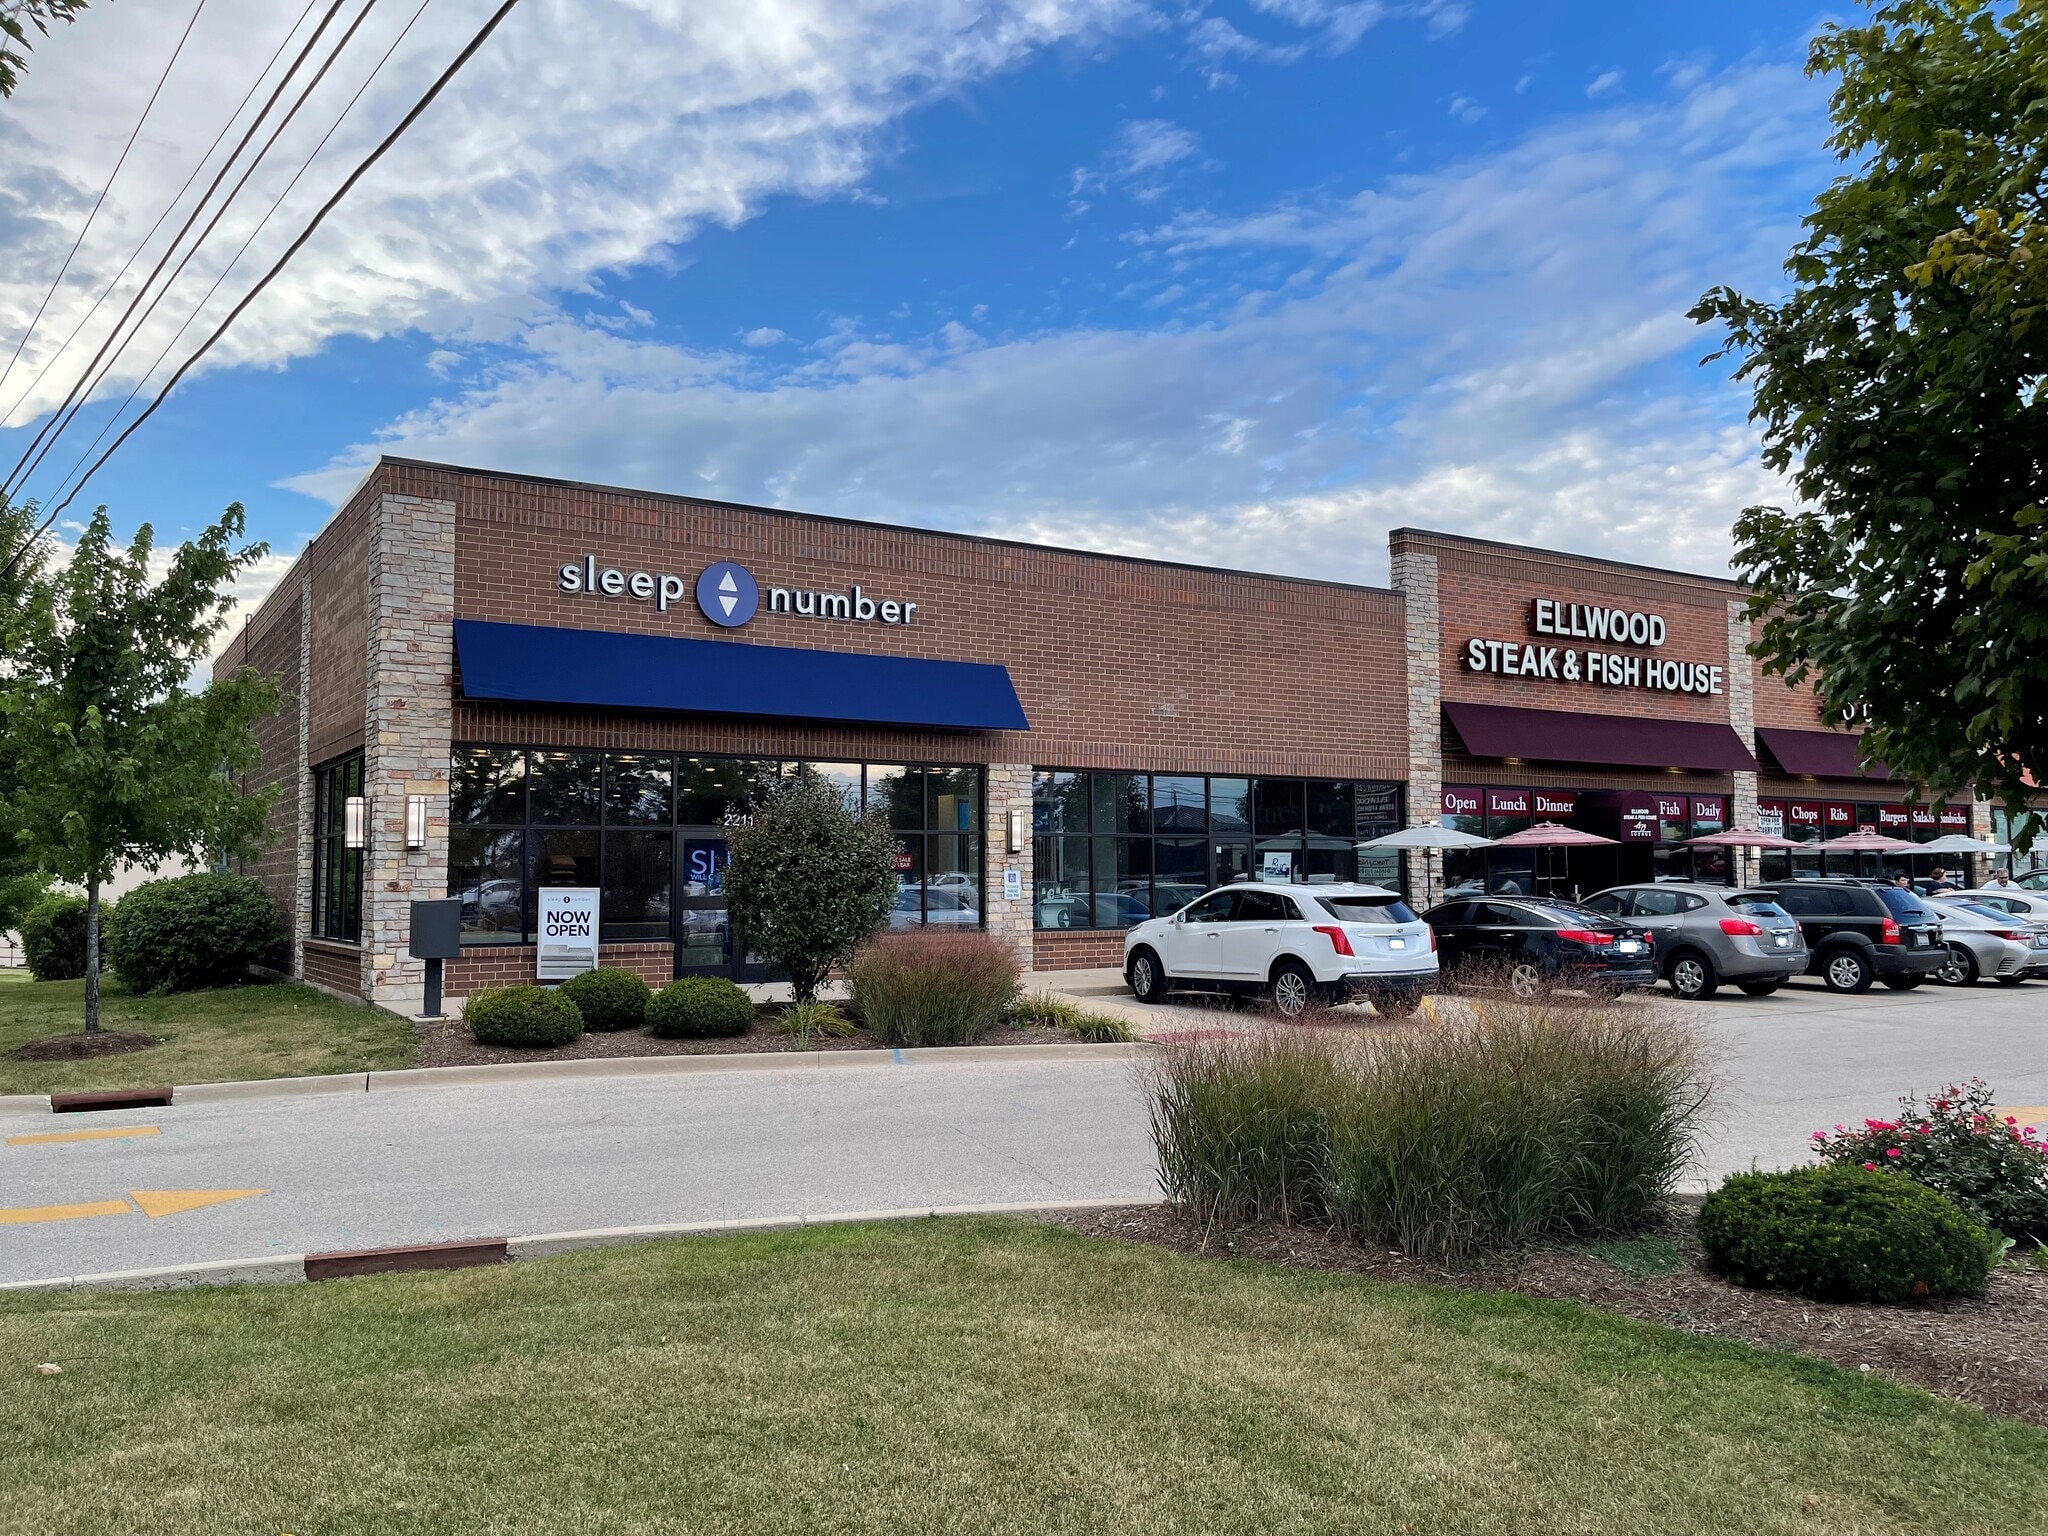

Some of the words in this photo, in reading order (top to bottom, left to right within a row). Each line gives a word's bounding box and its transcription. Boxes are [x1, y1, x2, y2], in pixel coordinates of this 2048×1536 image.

[559, 554, 684, 613] sleep
[767, 586, 917, 624] number
[1532, 598, 1666, 647] ELLWOOD
[1466, 638, 1558, 679] STEAK
[1562, 649, 1581, 681] &
[1586, 651, 1640, 687] FISH
[1645, 658, 1723, 695] HOUSE
[1445, 793, 1477, 813] Open
[1492, 795, 1527, 811] Lunch
[1536, 796, 1573, 812] Dinner
[1659, 801, 1680, 815] Fish
[1696, 802, 1721, 820] Daily
[1757, 804, 1783, 818] Steaks
[1792, 806, 1818, 823] Chops
[1830, 807, 1848, 820] Ribs
[1880, 809, 1908, 825] Burgers
[724, 814, 753, 826] 2211
[547, 911, 591, 923] NOW
[546, 925, 590, 936] OPEN
